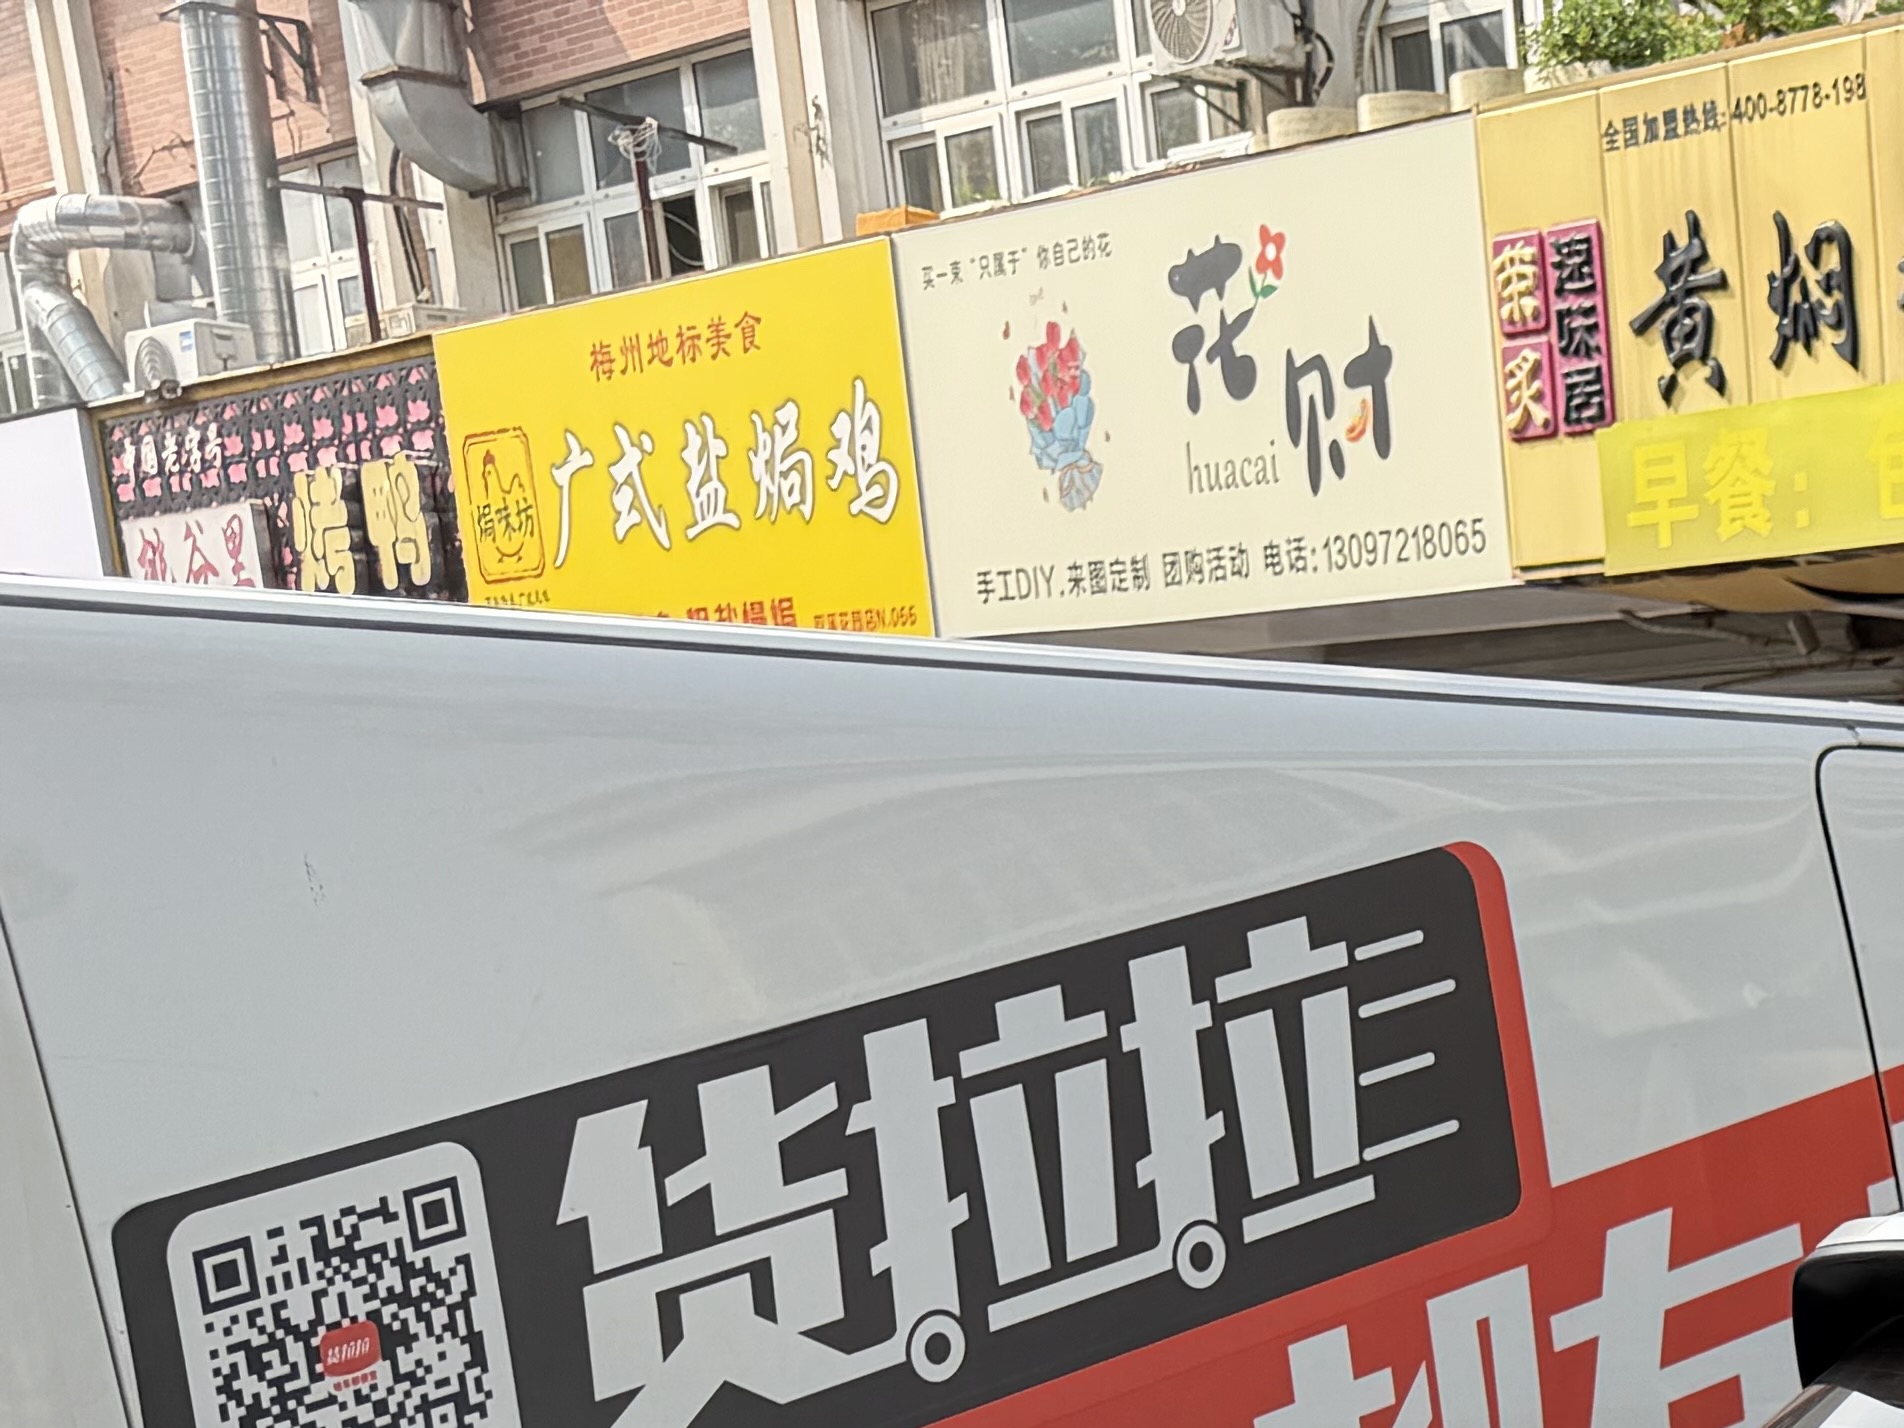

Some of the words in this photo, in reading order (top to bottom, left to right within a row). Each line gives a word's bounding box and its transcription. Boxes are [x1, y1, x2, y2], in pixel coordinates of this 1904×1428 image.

[589, 310, 763, 383] 梅州地标美食
[550, 376, 900, 570] 广式盐焗鸡
[1185, 440, 1281, 495] huacai
[291, 450, 432, 597] 烤鸭
[1162, 540, 1251, 589] 团购活动
[1262, 517, 1488, 577] 电话:13097218065
